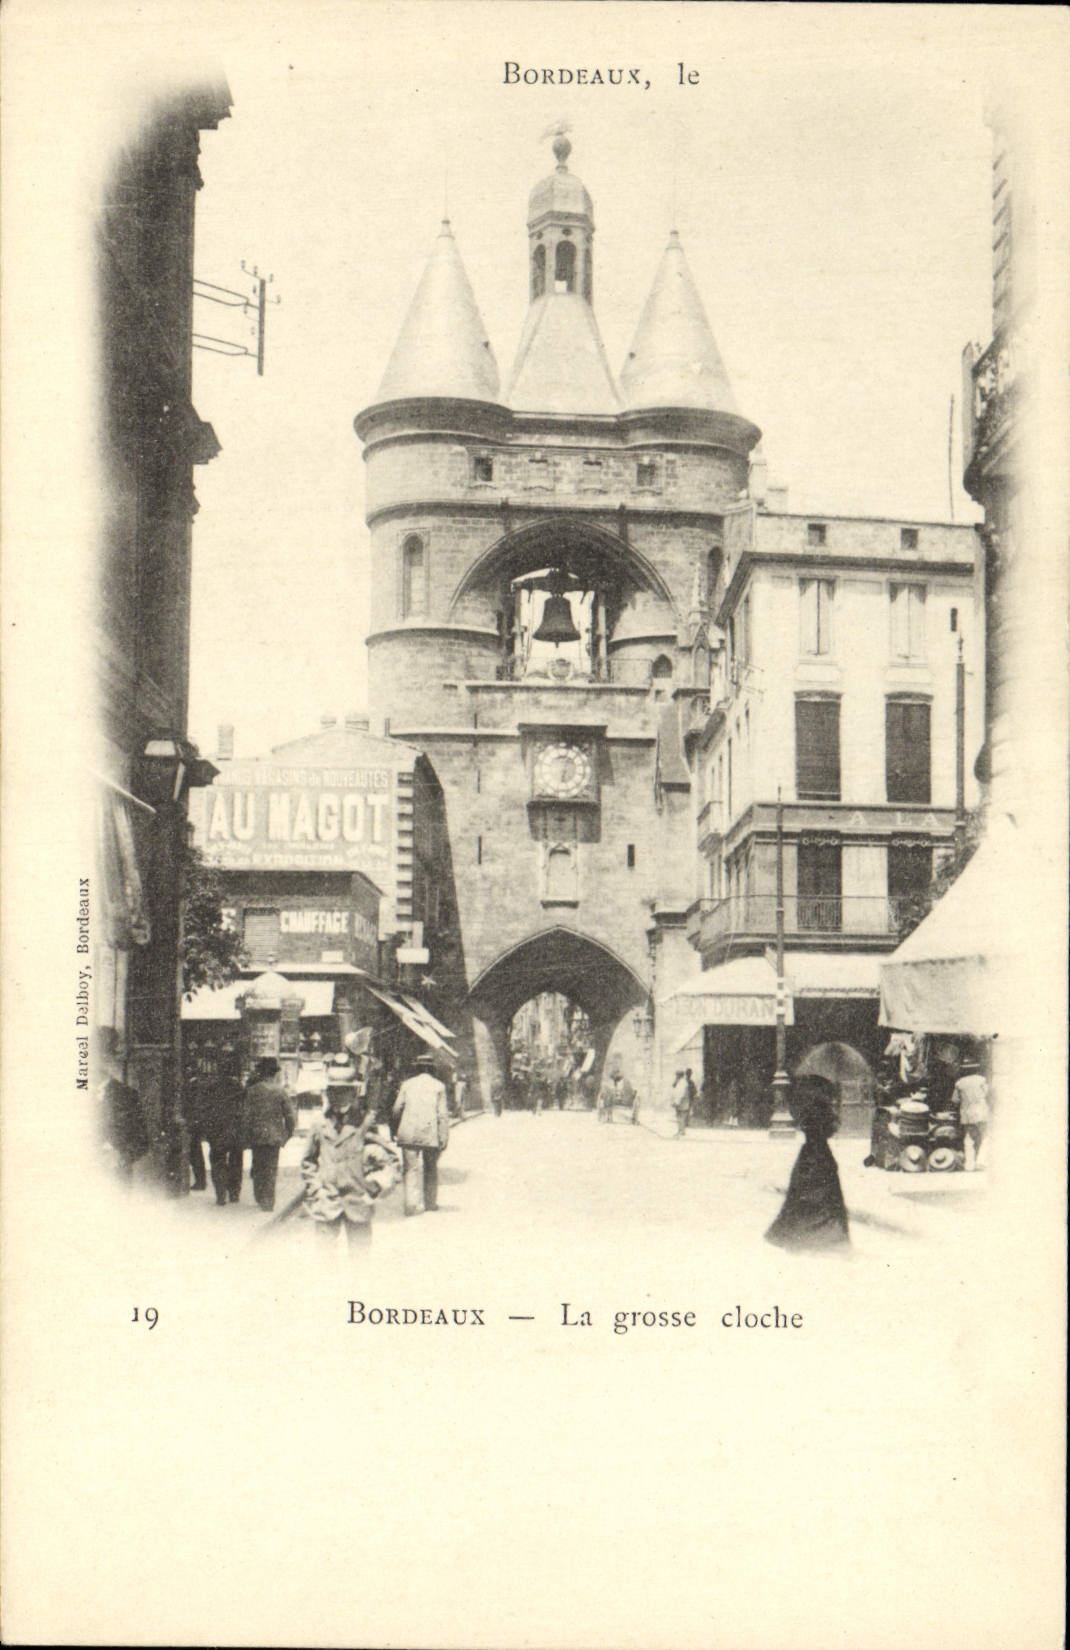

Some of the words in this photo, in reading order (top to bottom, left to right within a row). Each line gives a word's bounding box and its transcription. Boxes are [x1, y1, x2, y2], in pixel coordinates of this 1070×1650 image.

[208, 791, 254, 840] AU
[268, 792, 389, 842] MAGOT
[849, 811, 867, 826] A
[896, 812, 940, 827] LA
[280, 910, 349, 933] CHAUFFAGE
